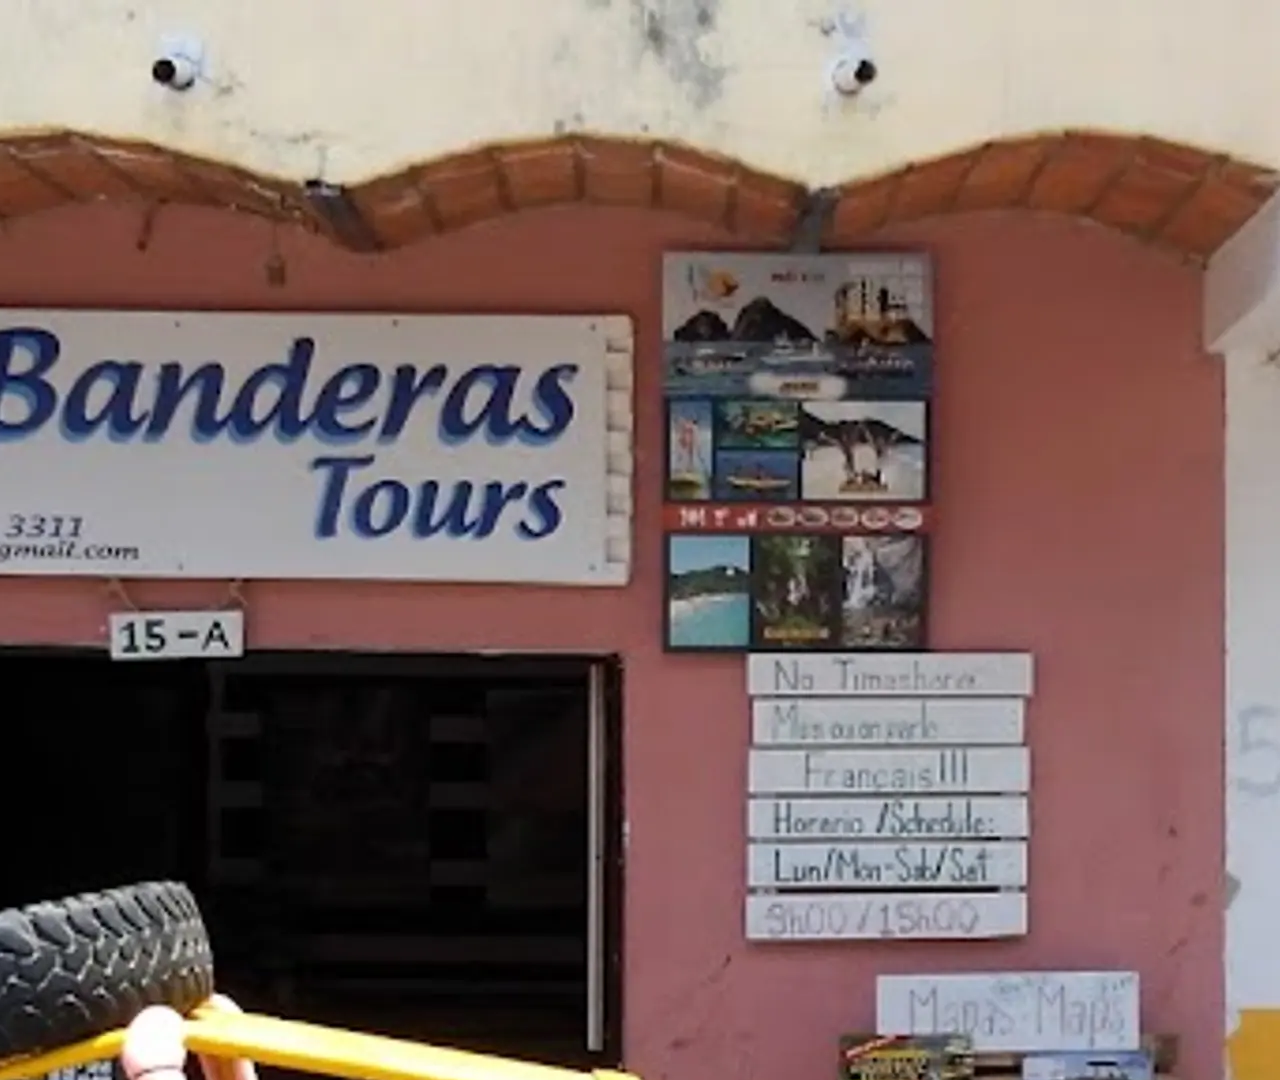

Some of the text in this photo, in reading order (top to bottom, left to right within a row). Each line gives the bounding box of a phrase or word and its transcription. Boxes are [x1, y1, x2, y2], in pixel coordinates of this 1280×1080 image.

[310, 453, 566, 539] Tours
[4, 514, 84, 539] 3311
[774, 659, 814, 691] No
